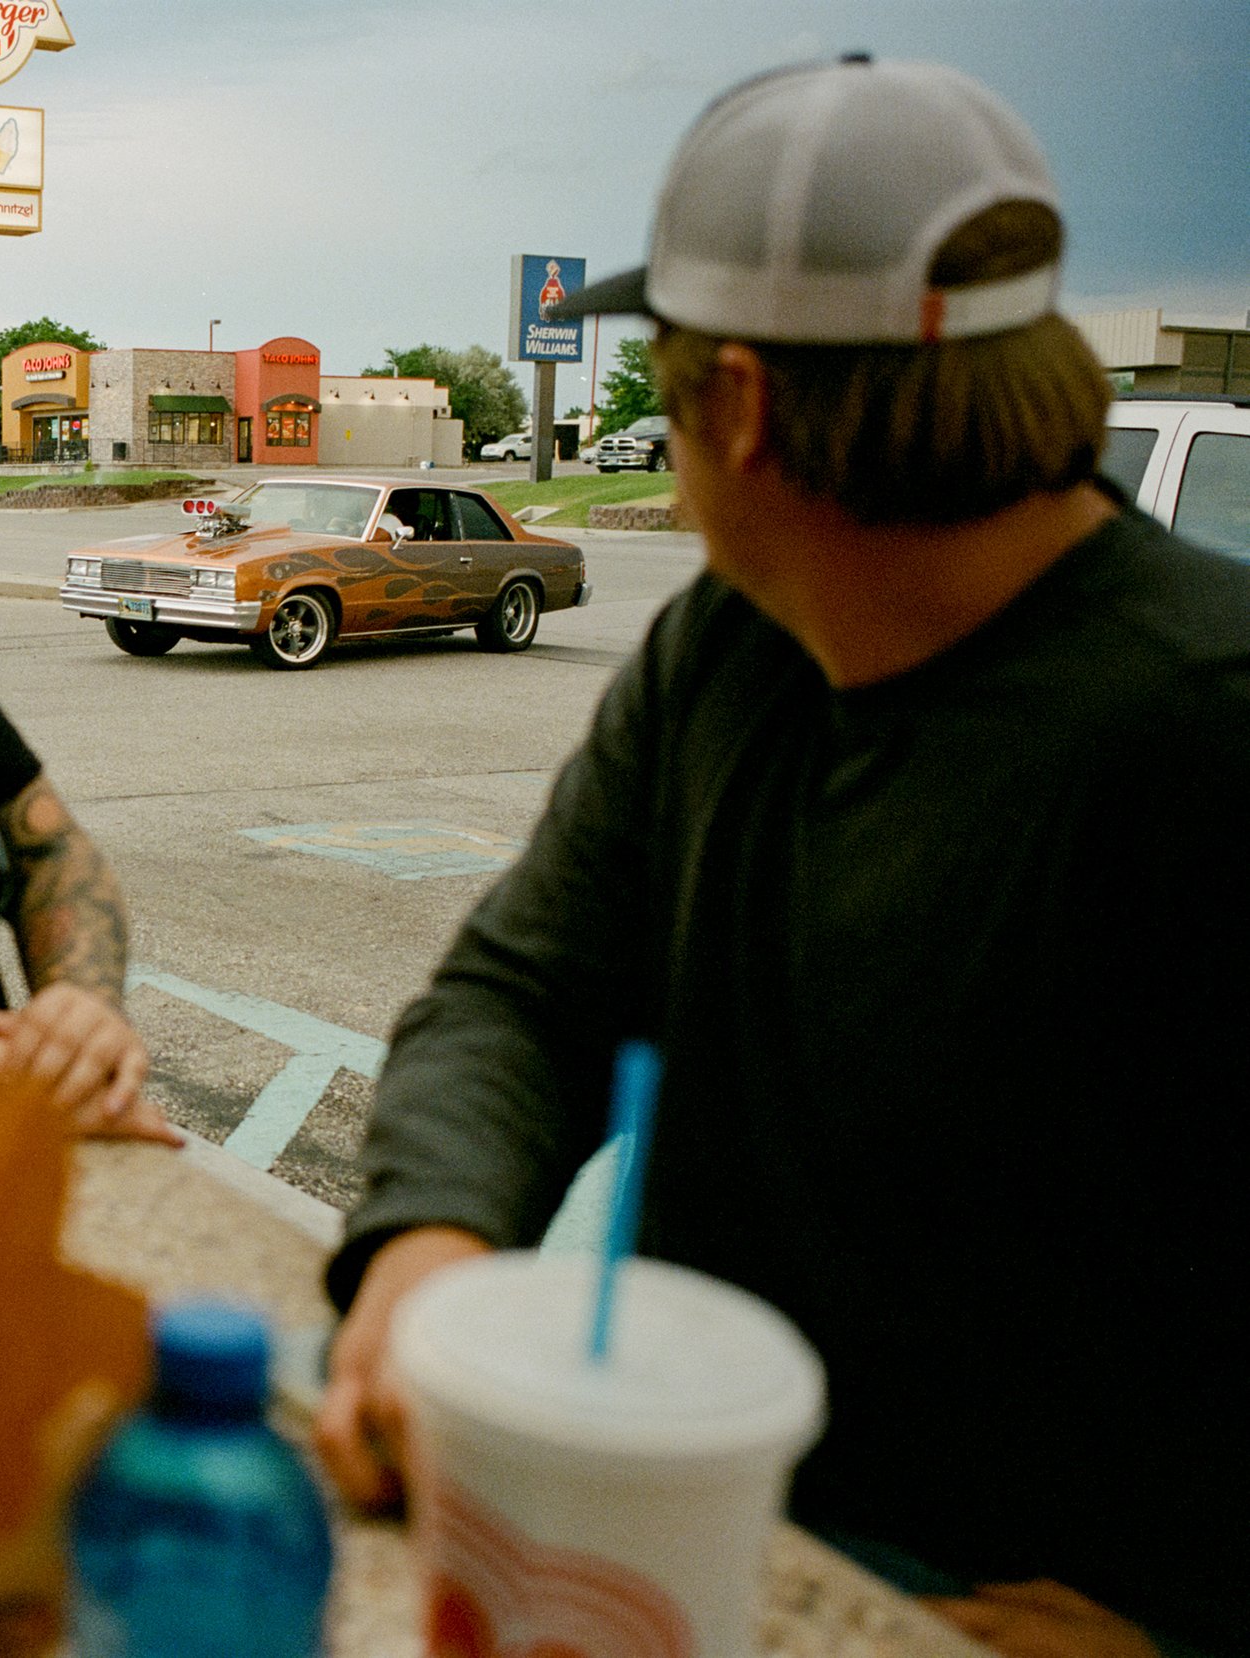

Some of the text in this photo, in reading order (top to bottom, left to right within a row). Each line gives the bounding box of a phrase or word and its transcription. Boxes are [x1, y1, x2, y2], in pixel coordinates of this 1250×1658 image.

[526, 324, 577, 340] SHERWIN
[22, 353, 70, 372] TACO JOHN'S
[263, 352, 288, 363] TACO
